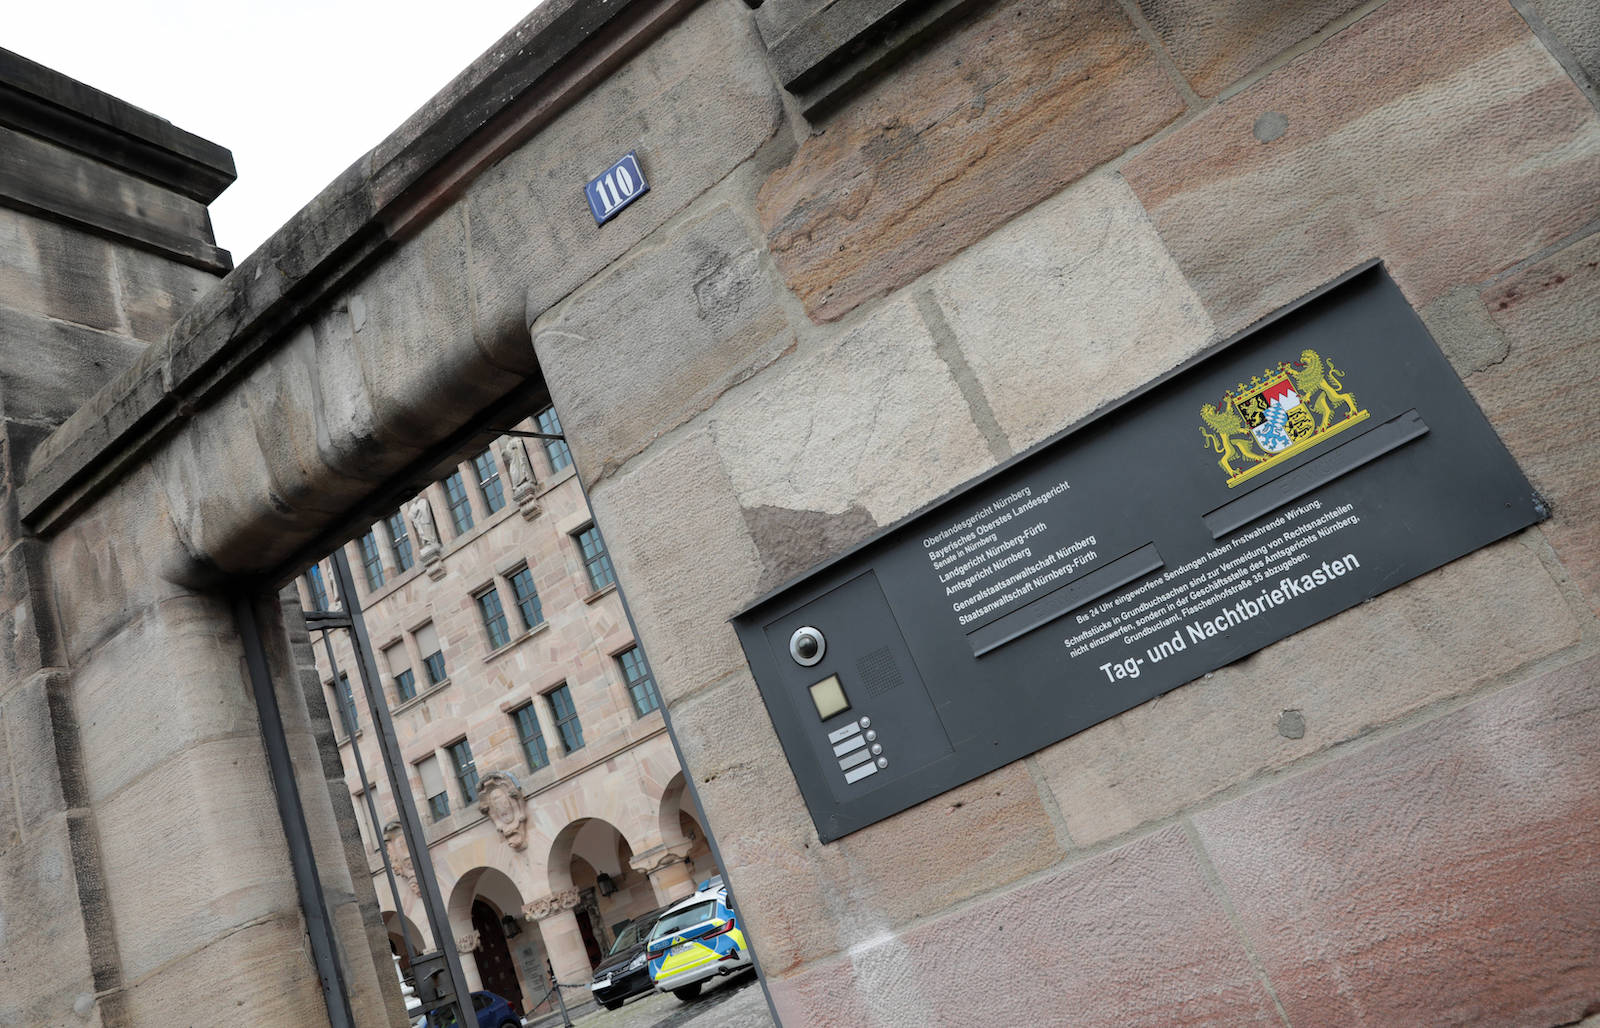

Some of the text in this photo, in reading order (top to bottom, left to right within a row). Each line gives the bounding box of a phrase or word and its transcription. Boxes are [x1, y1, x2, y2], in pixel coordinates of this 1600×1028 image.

[596, 166, 634, 214] 110
[923, 486, 1031, 548] Oberlandesgericht Nürnberg
[929, 481, 1070, 561] Bayerisches Oberstes Landesgericht
[934, 532, 997, 570] Senate in Nürnberg
[939, 521, 1047, 583] Landgericht Nürnberg-Fürth
[945, 547, 1032, 596] Amtsgericht Nürnberg
[953, 555, 1056, 612] Generalstaatsanwaltschaft
[1056, 534, 1096, 561] Nürnberg
[959, 583, 1034, 626] Staatsanwaltschaft
[1033, 550, 1097, 589] Nürnberg-Fürth
[1070, 515, 1360, 658] nicht einzuwerfen, sondern in der Geschäftsstelle des Amtsgerichts Nürnberg,
[1090, 608, 1099, 618] 24
[1099, 602, 1114, 613] Uhr
[1115, 577, 1163, 606] eingeworfene
[1164, 556, 1207, 581] Sendungen
[1207, 544, 1232, 560] haben
[1285, 500, 1322, 521] Wirkung.
[1112, 616, 1120, 624] in
[1121, 583, 1189, 620] Grundbuchsachen
[1189, 574, 1206, 588] sind
[1206, 570, 1220, 579] zur
[1219, 544, 1268, 572] Vermeidung
[1268, 538, 1283, 548] von
[1284, 503, 1353, 541] Rechtsnachteilen
[1181, 579, 1252, 617] Flaschenhofstraße
[1252, 573, 1264, 583] 35
[1264, 554, 1310, 578] abzugeben.
[1100, 553, 1360, 683] Tag- und Nachtbriefkasten
